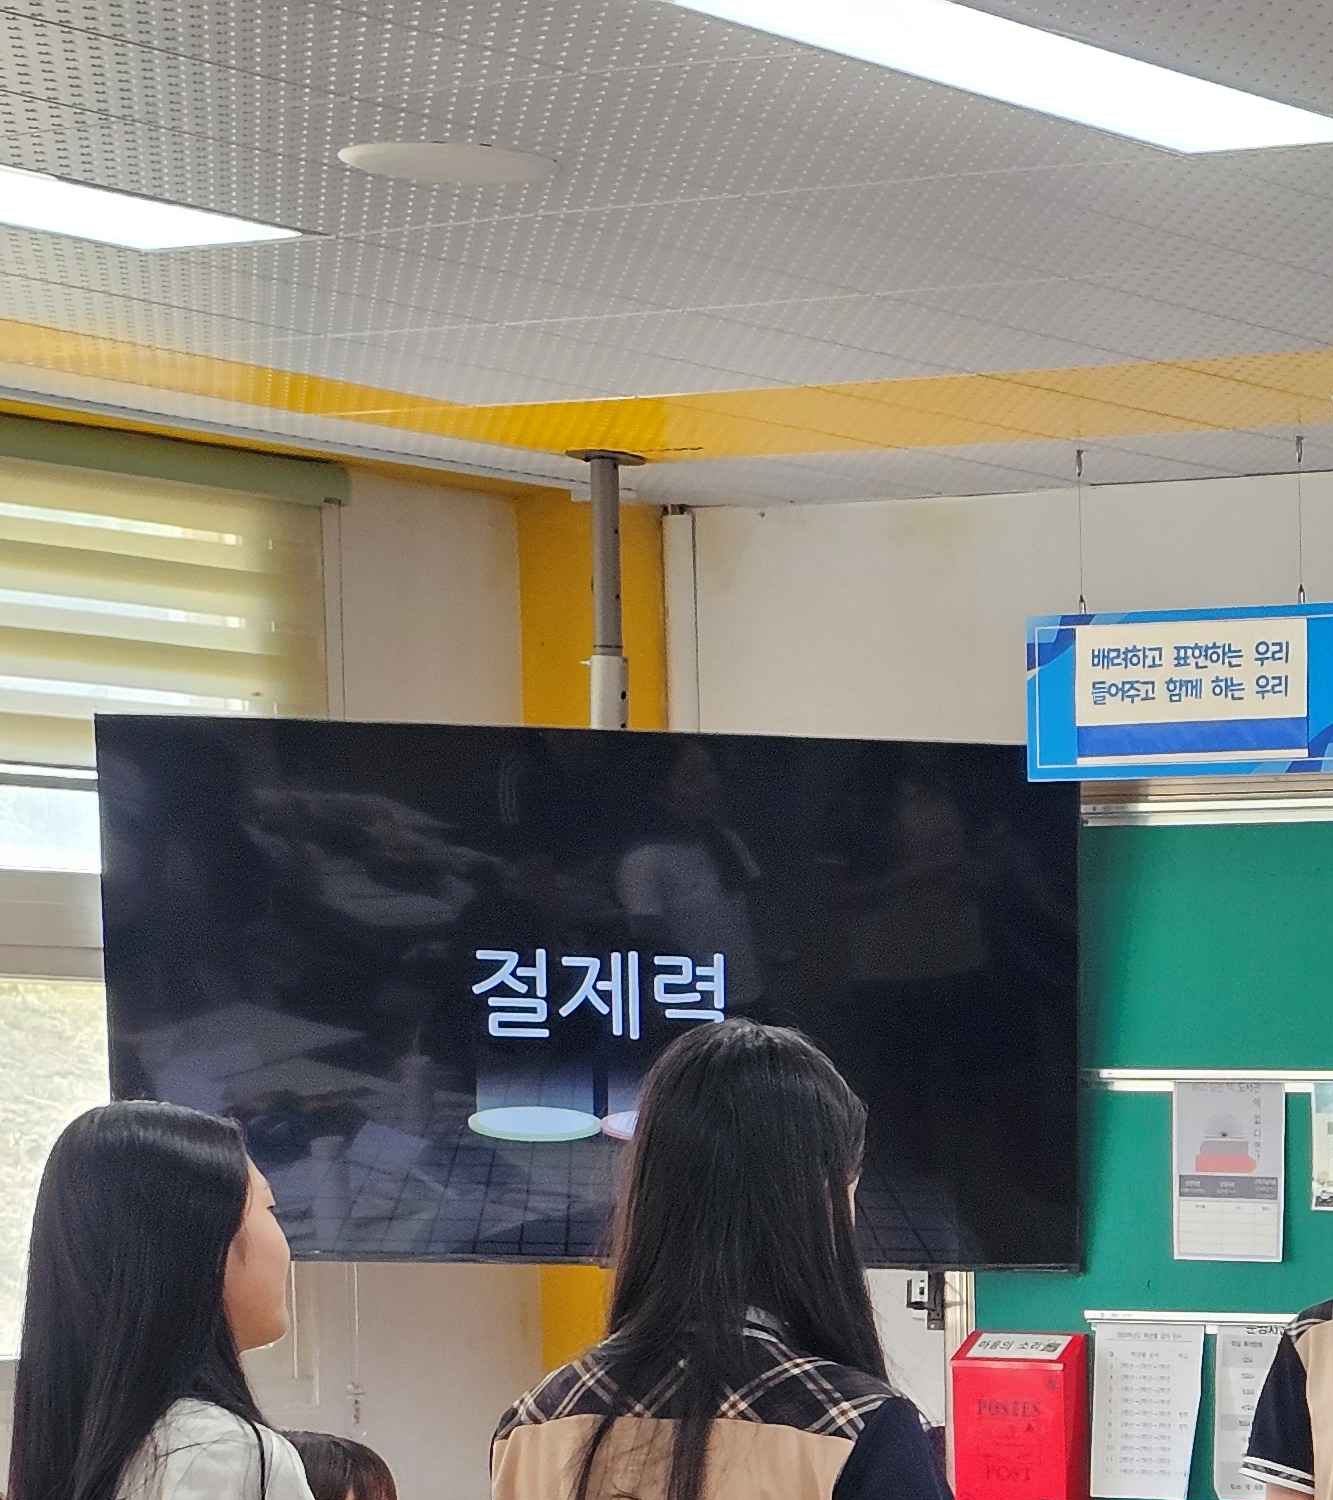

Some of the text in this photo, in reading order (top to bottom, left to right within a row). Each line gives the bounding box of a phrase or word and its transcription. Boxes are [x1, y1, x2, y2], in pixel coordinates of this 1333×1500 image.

[1091, 641, 1289, 670] 배려하고 표현하는 우리
[1091, 675, 1288, 705] 들어주고 함께 하는 우리
[472, 948, 726, 1040] 절제력
